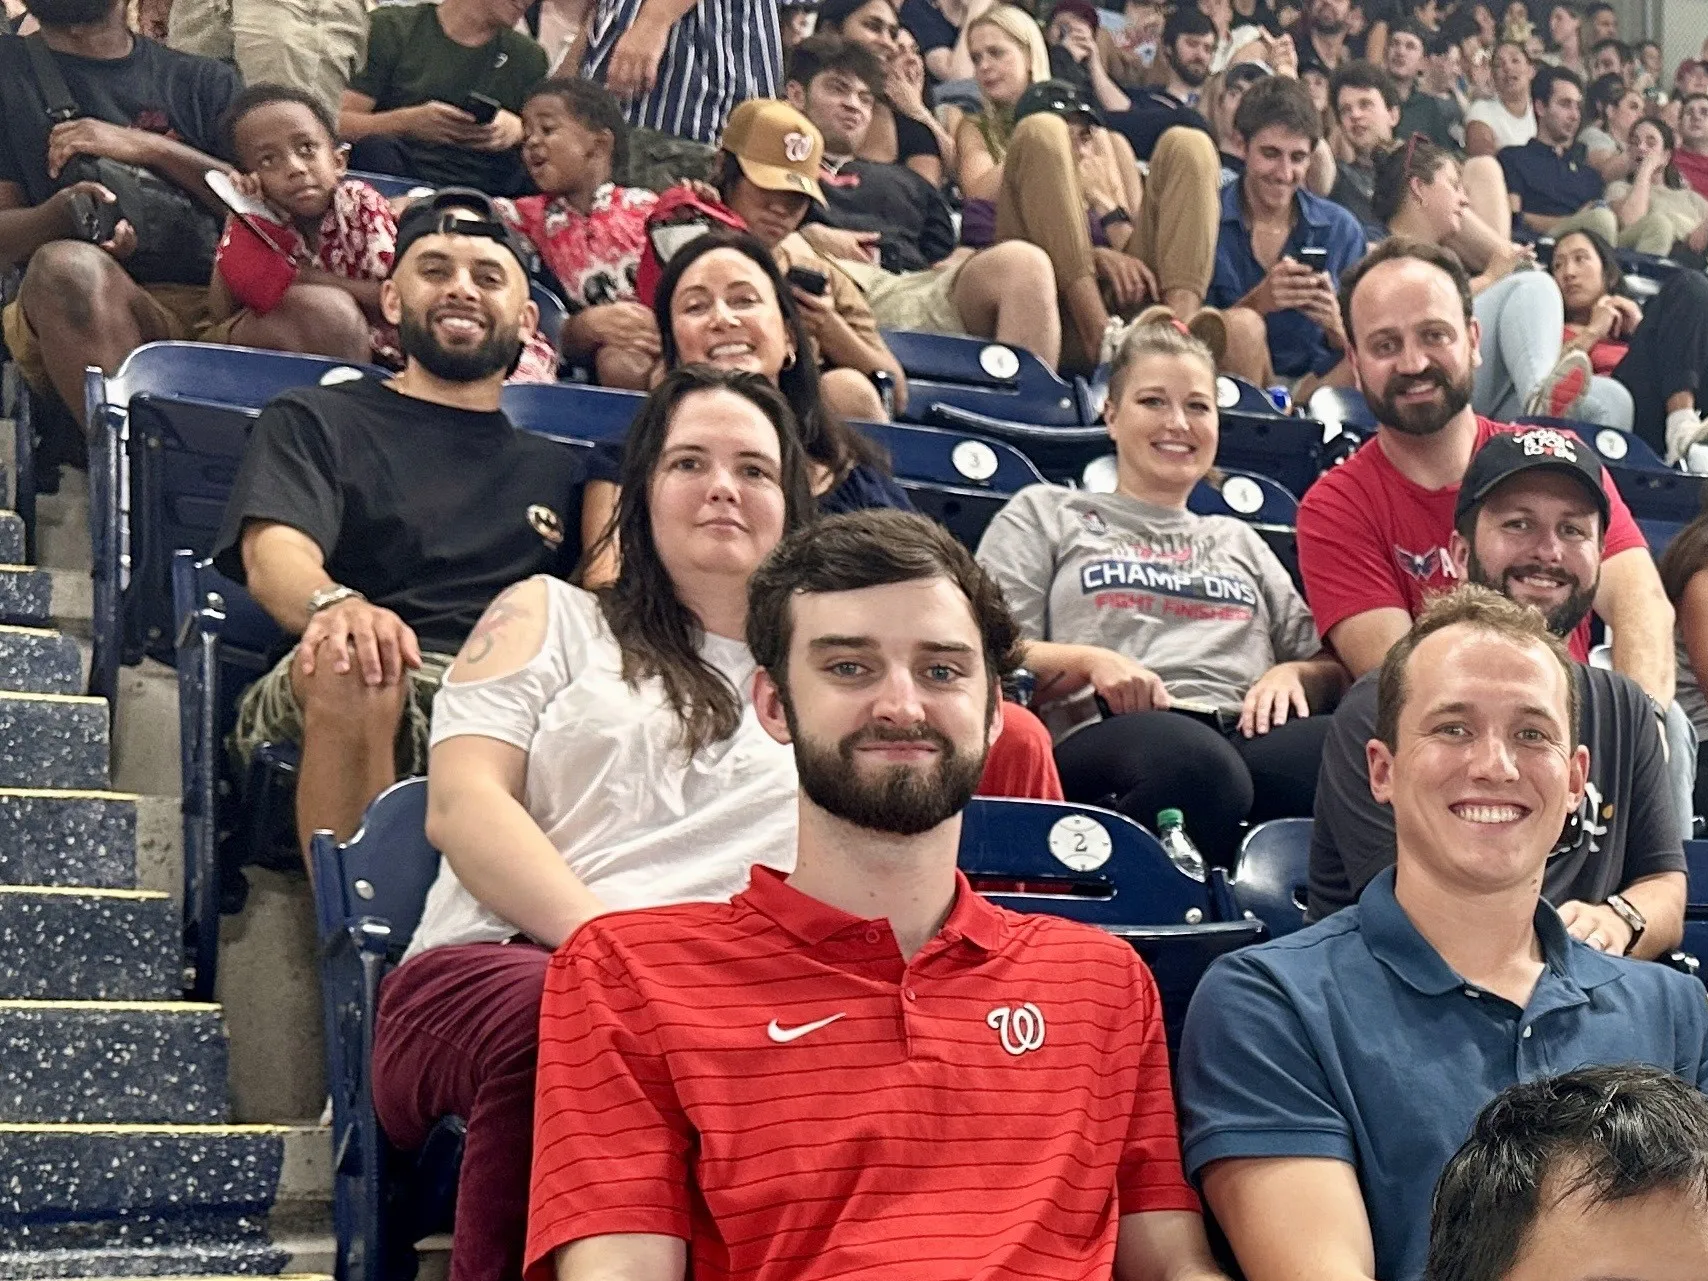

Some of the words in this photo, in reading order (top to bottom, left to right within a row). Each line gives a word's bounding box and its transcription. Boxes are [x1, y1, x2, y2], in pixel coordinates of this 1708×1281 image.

[1083, 562, 1257, 606] CHAMPONS
[1073, 832, 1088, 853] 2
[986, 1001, 1046, 1056] W
